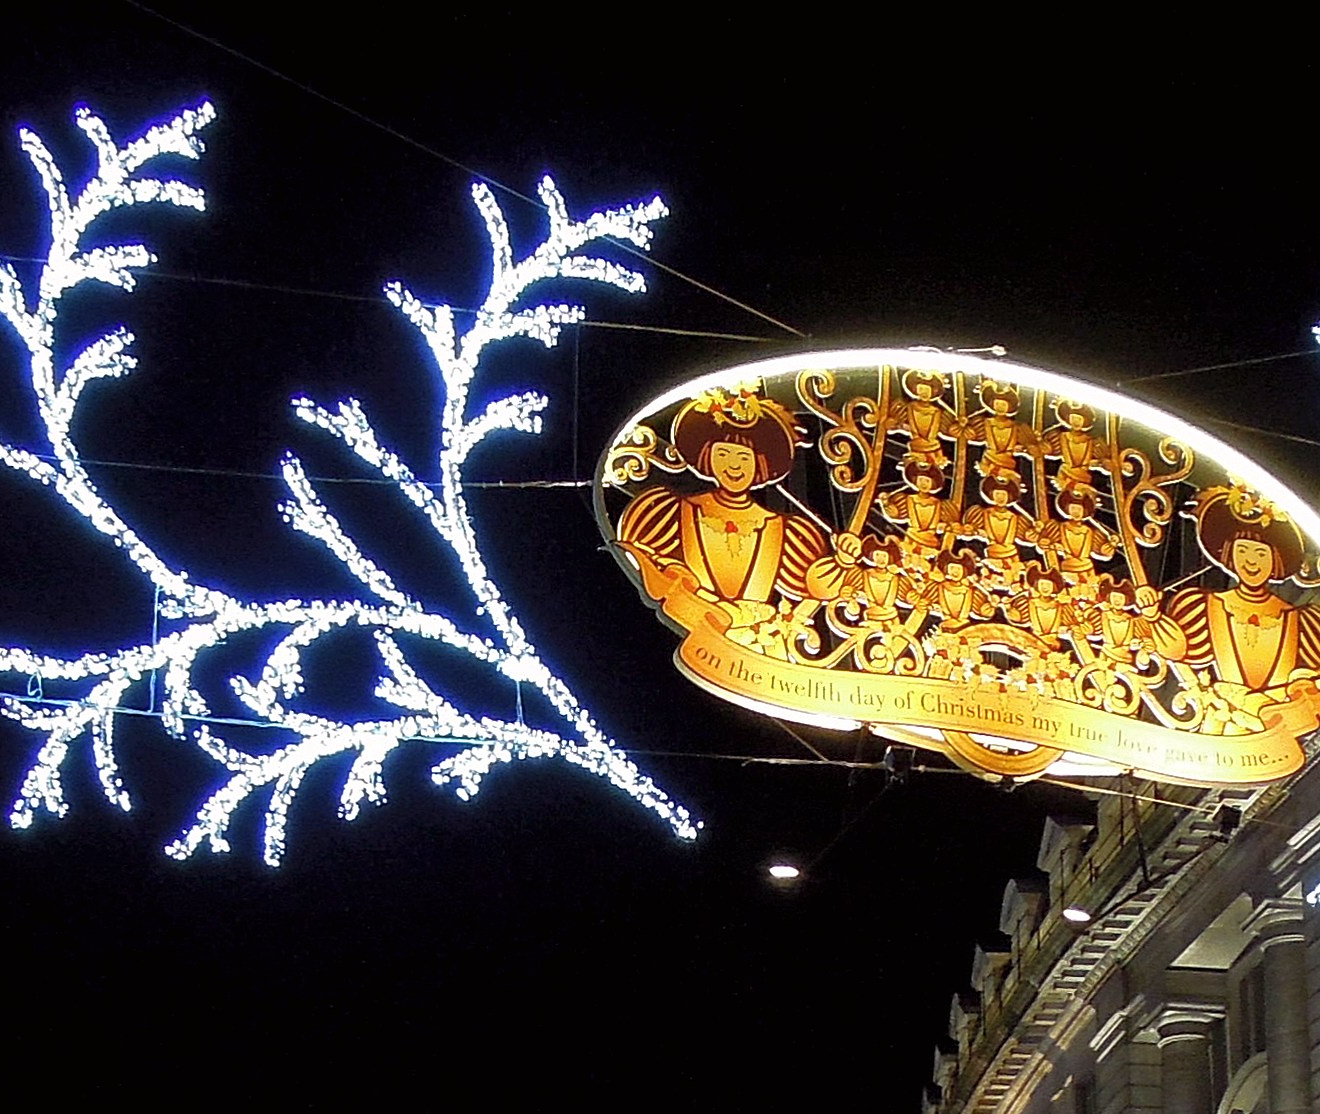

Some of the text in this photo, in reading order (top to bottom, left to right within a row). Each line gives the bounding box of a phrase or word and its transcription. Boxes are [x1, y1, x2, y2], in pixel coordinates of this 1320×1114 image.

[695, 645, 722, 670] on
[728, 659, 763, 686] the
[769, 673, 841, 703] twelfth
[850, 685, 886, 713] day
[893, 690, 915, 711] of
[920, 692, 1025, 726] Christmas
[1030, 715, 1063, 738] my
[1069, 721, 1110, 743] true
[1116, 728, 1158, 754] love
[1164, 745, 1209, 764] gave
[1215, 751, 1234, 769] to
